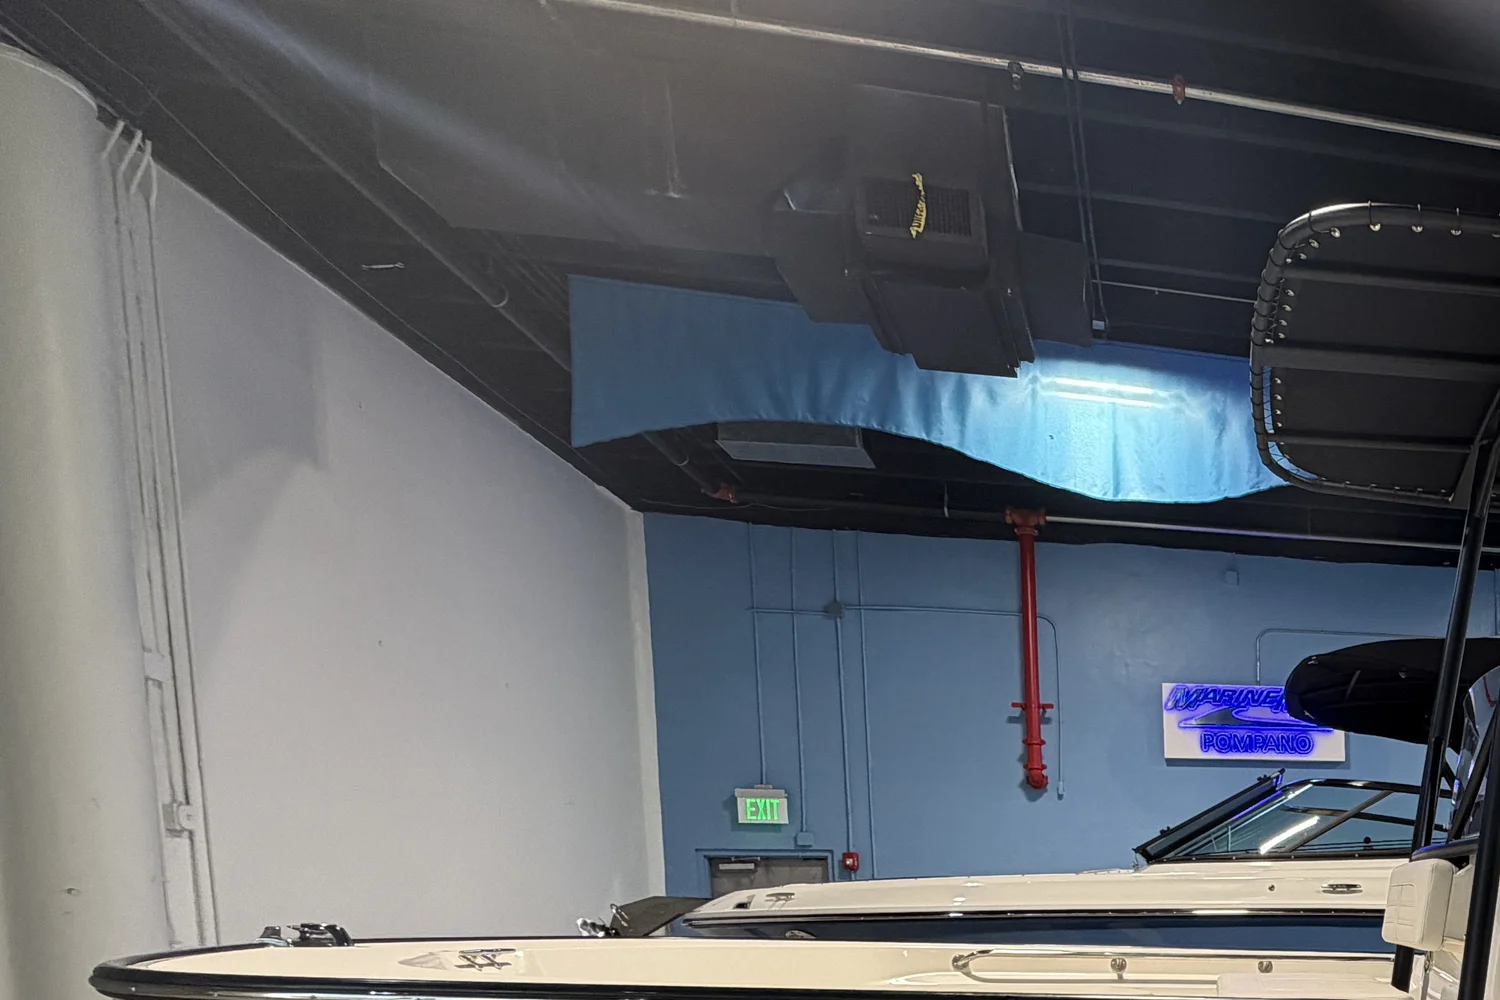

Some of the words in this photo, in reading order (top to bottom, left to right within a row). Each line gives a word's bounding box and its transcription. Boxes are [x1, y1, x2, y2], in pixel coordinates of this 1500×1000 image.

[1165, 685, 1286, 713] MARINE
[1200, 732, 1314, 755] POMPANO
[746, 798, 780, 821] EXIT
